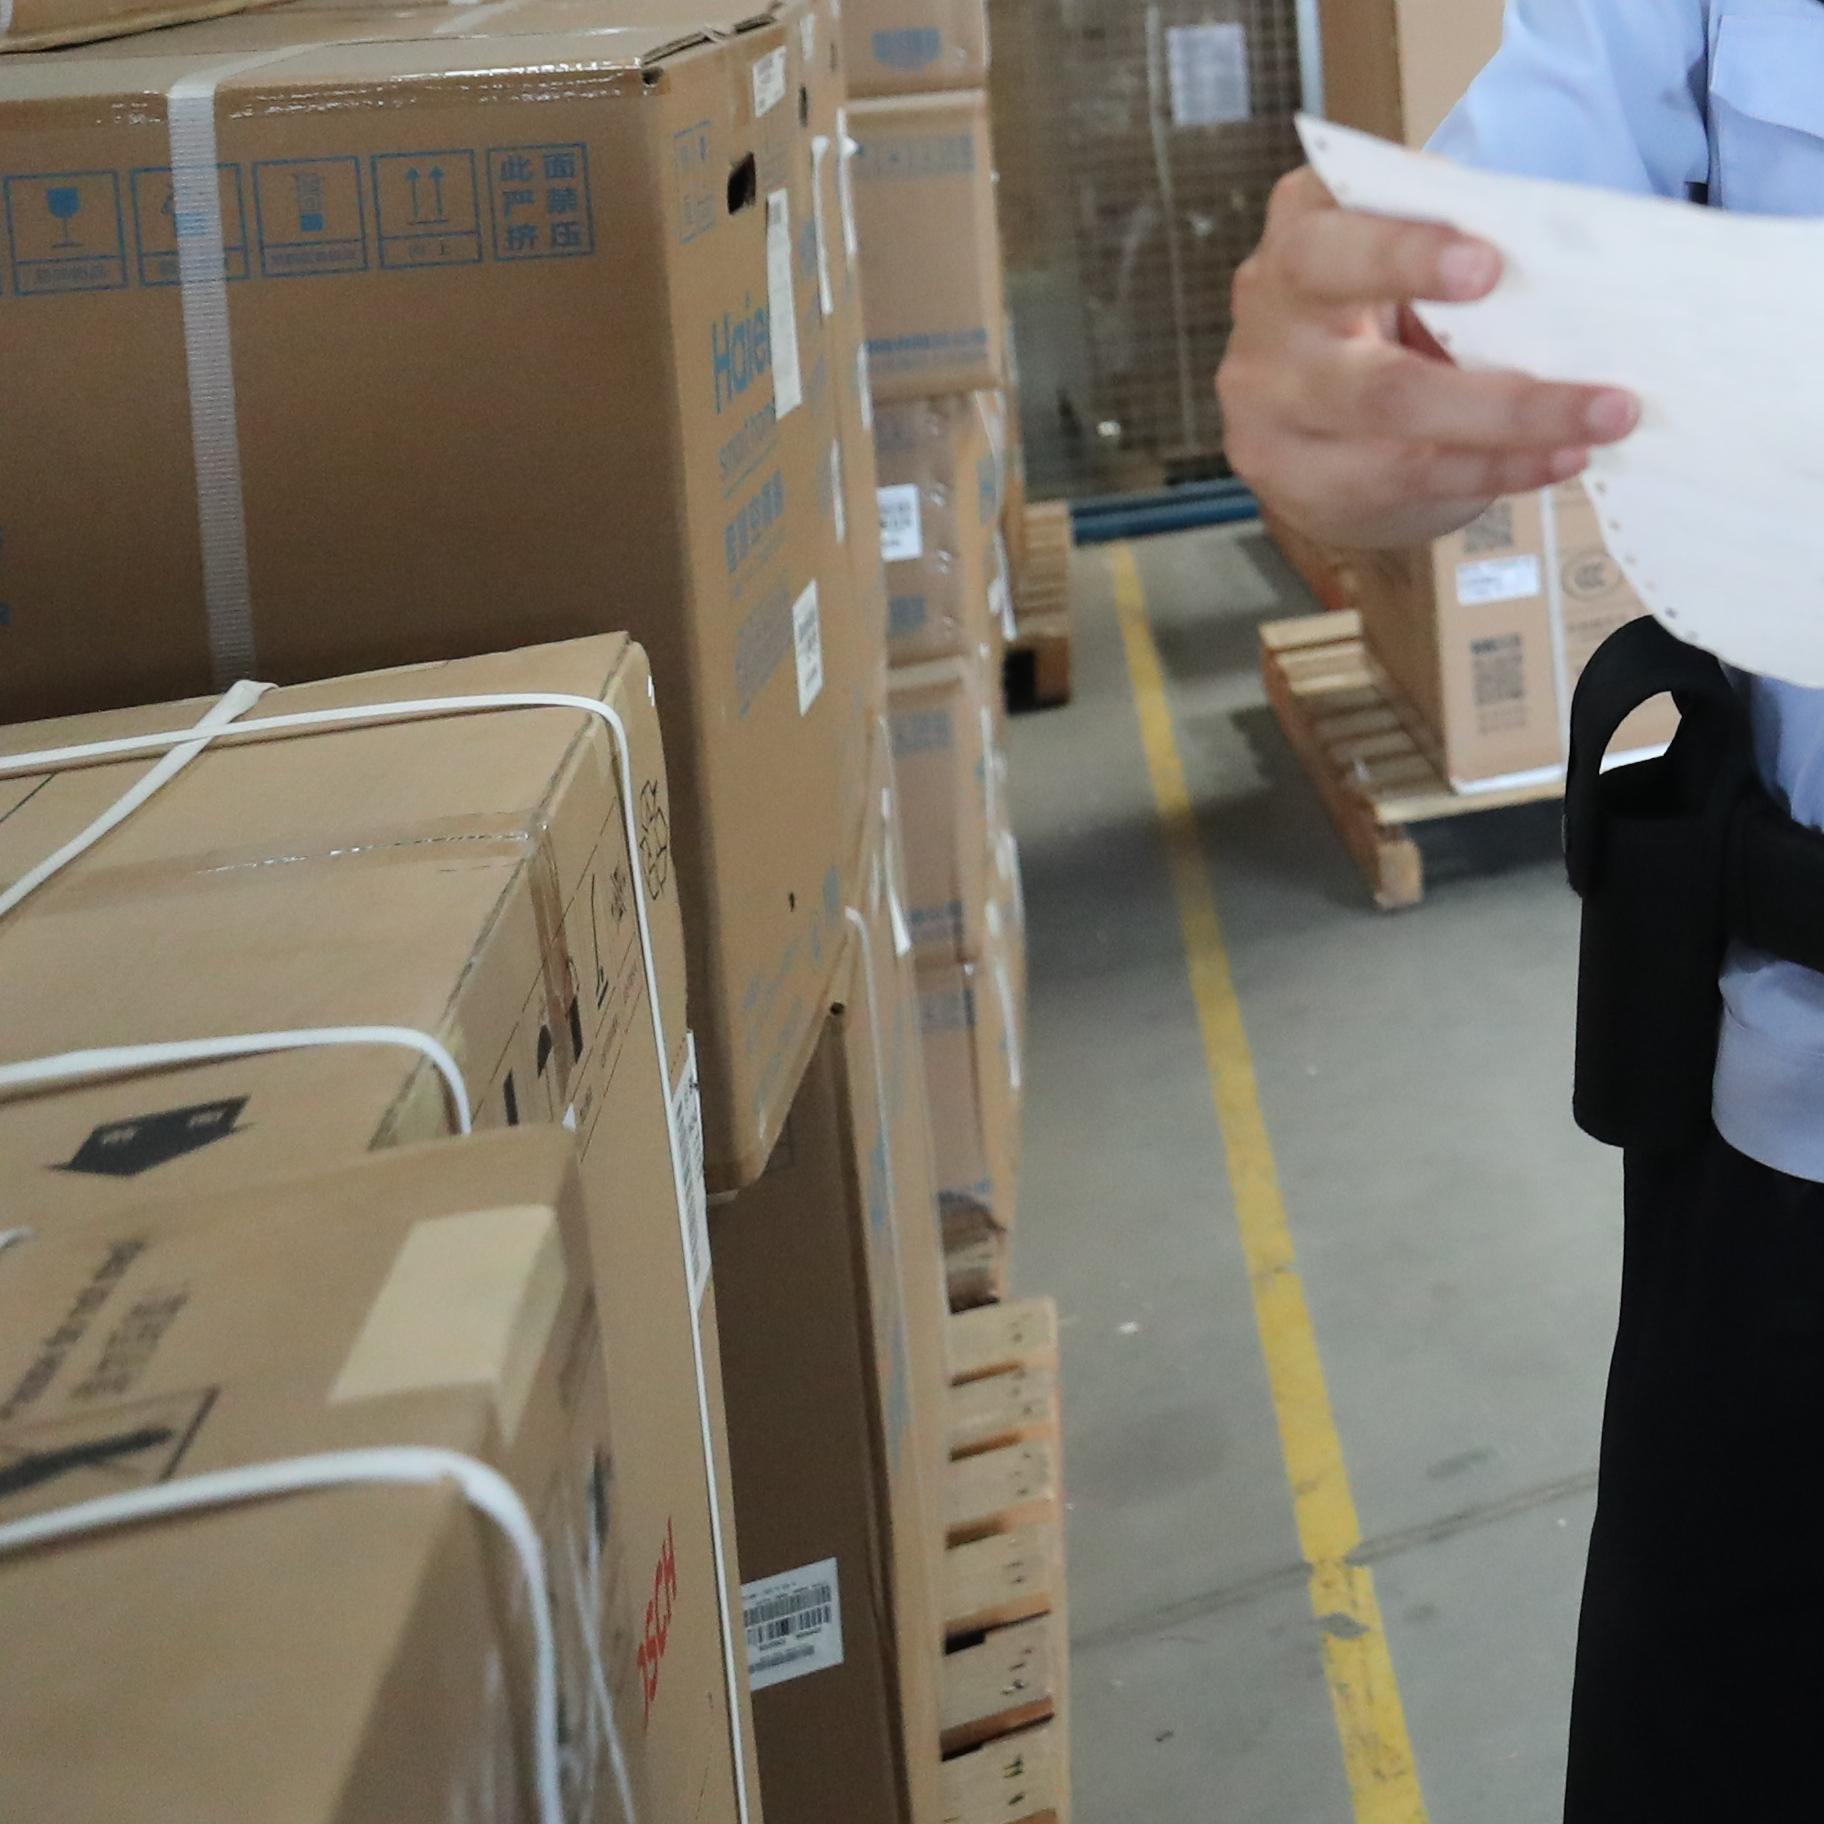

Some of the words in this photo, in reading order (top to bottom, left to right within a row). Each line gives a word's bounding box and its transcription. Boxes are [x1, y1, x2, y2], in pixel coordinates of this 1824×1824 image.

[501, 152, 577, 181] 此面
[502, 187, 578, 219] 严禁
[506, 221, 581, 251] 挤压
[711, 289, 771, 416] Haie
